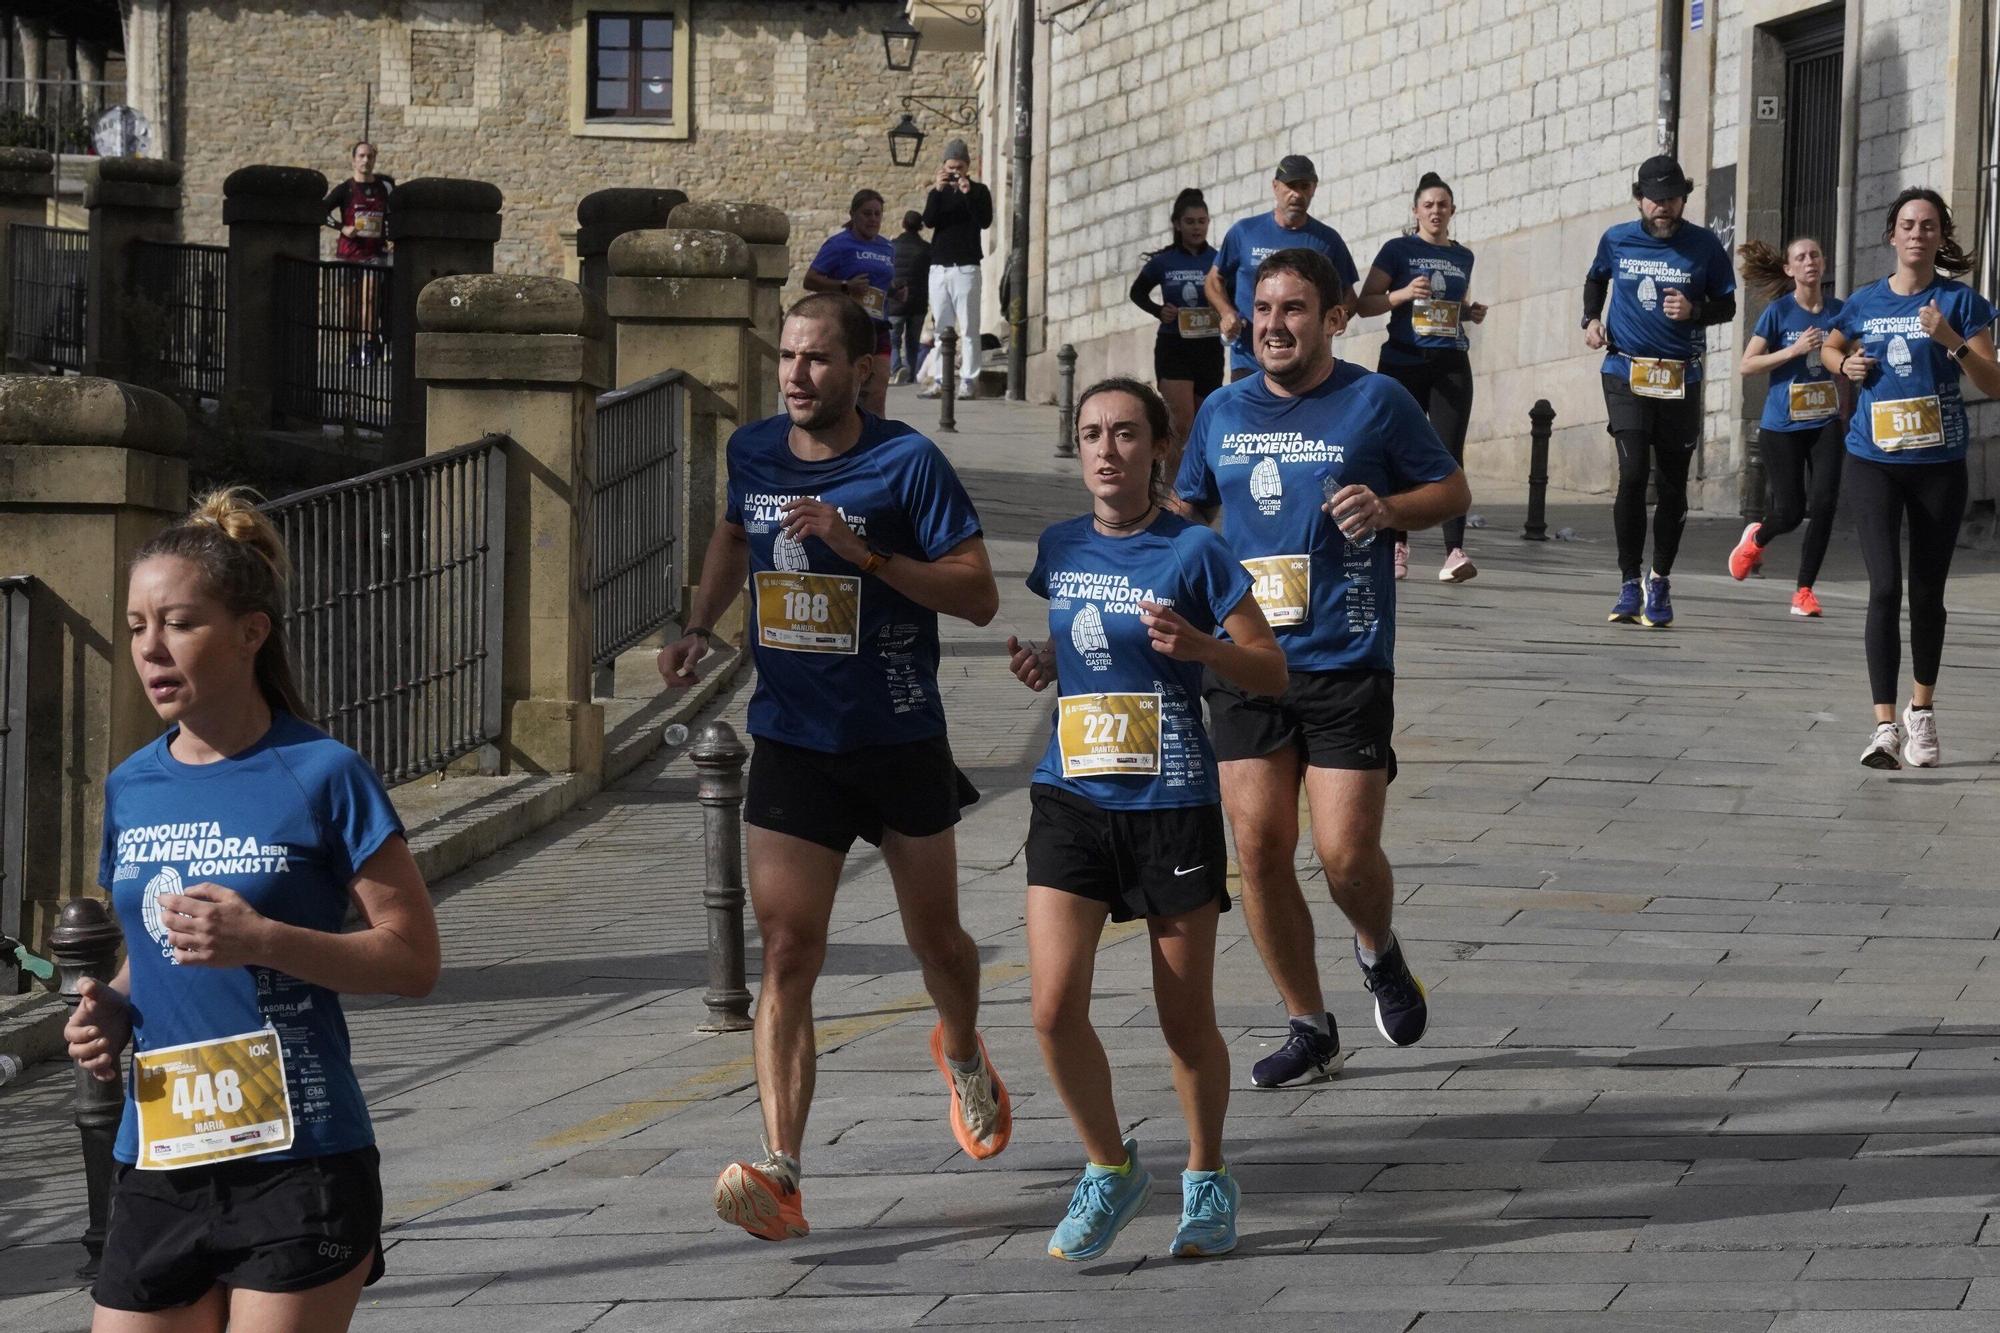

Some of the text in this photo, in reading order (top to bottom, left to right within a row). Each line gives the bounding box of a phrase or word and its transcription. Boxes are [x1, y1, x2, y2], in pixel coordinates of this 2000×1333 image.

[1628, 259, 1668, 268] CONQUISTA
[1628, 265, 1682, 277] ALMENDRA
[1655, 276, 1691, 284] KONKISTA
[1892, 411, 1921, 432] 511
[1223, 432, 1302, 444] LA CONQUISTA
[1235, 440, 1326, 455] ALMENDRA
[1280, 452, 1344, 463] KONKISTA
[745, 493, 754, 504] LA
[847, 515, 866, 524] REN
[1291, 562, 1303, 570] 10K
[1049, 571, 1129, 588] LA CONQUISTA
[839, 583, 853, 592] 10K
[1251, 574, 1284, 601] 45
[1056, 582, 1155, 603] ALMENDRA
[1157, 597, 1175, 607] REN
[783, 592, 829, 623] 188
[791, 623, 817, 632] MANUEL
[1085, 658, 1112, 666] GASTEIZ
[1139, 701, 1154, 709] 10K
[1083, 713, 1128, 744] 227
[1091, 746, 1119, 754] ARANTZA
[124, 822, 221, 844] CONQUISTA
[121, 837, 259, 864] ALMENDRA
[261, 846, 288, 856] REN
[187, 858, 290, 877] KONKISTA
[258, 1003, 297, 1014] LABORAL
[249, 1043, 270, 1058] 10K
[172, 1069, 243, 1120] 448
[194, 1119, 225, 1134] MARIA
